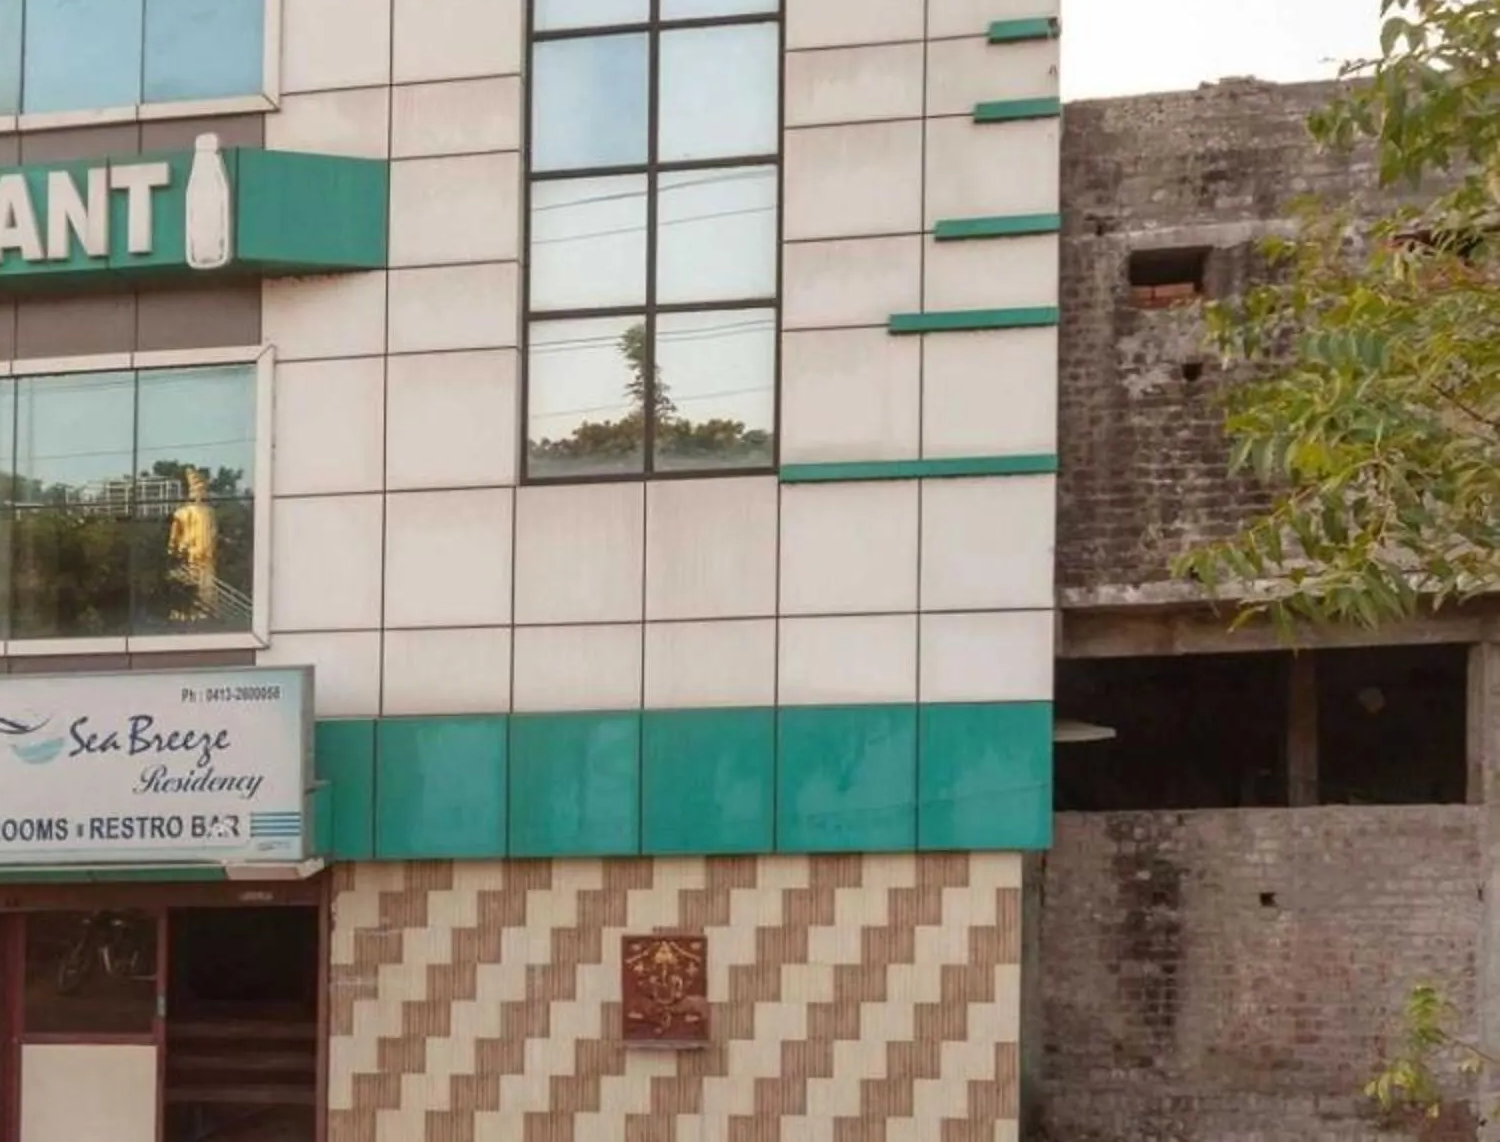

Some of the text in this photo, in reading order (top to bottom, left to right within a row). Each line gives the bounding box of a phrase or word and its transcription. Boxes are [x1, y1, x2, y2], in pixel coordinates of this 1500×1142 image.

[69, 714, 231, 768] Sea Breeze
[132, 764, 264, 799] Residency
[89, 815, 184, 841] RESTRO
